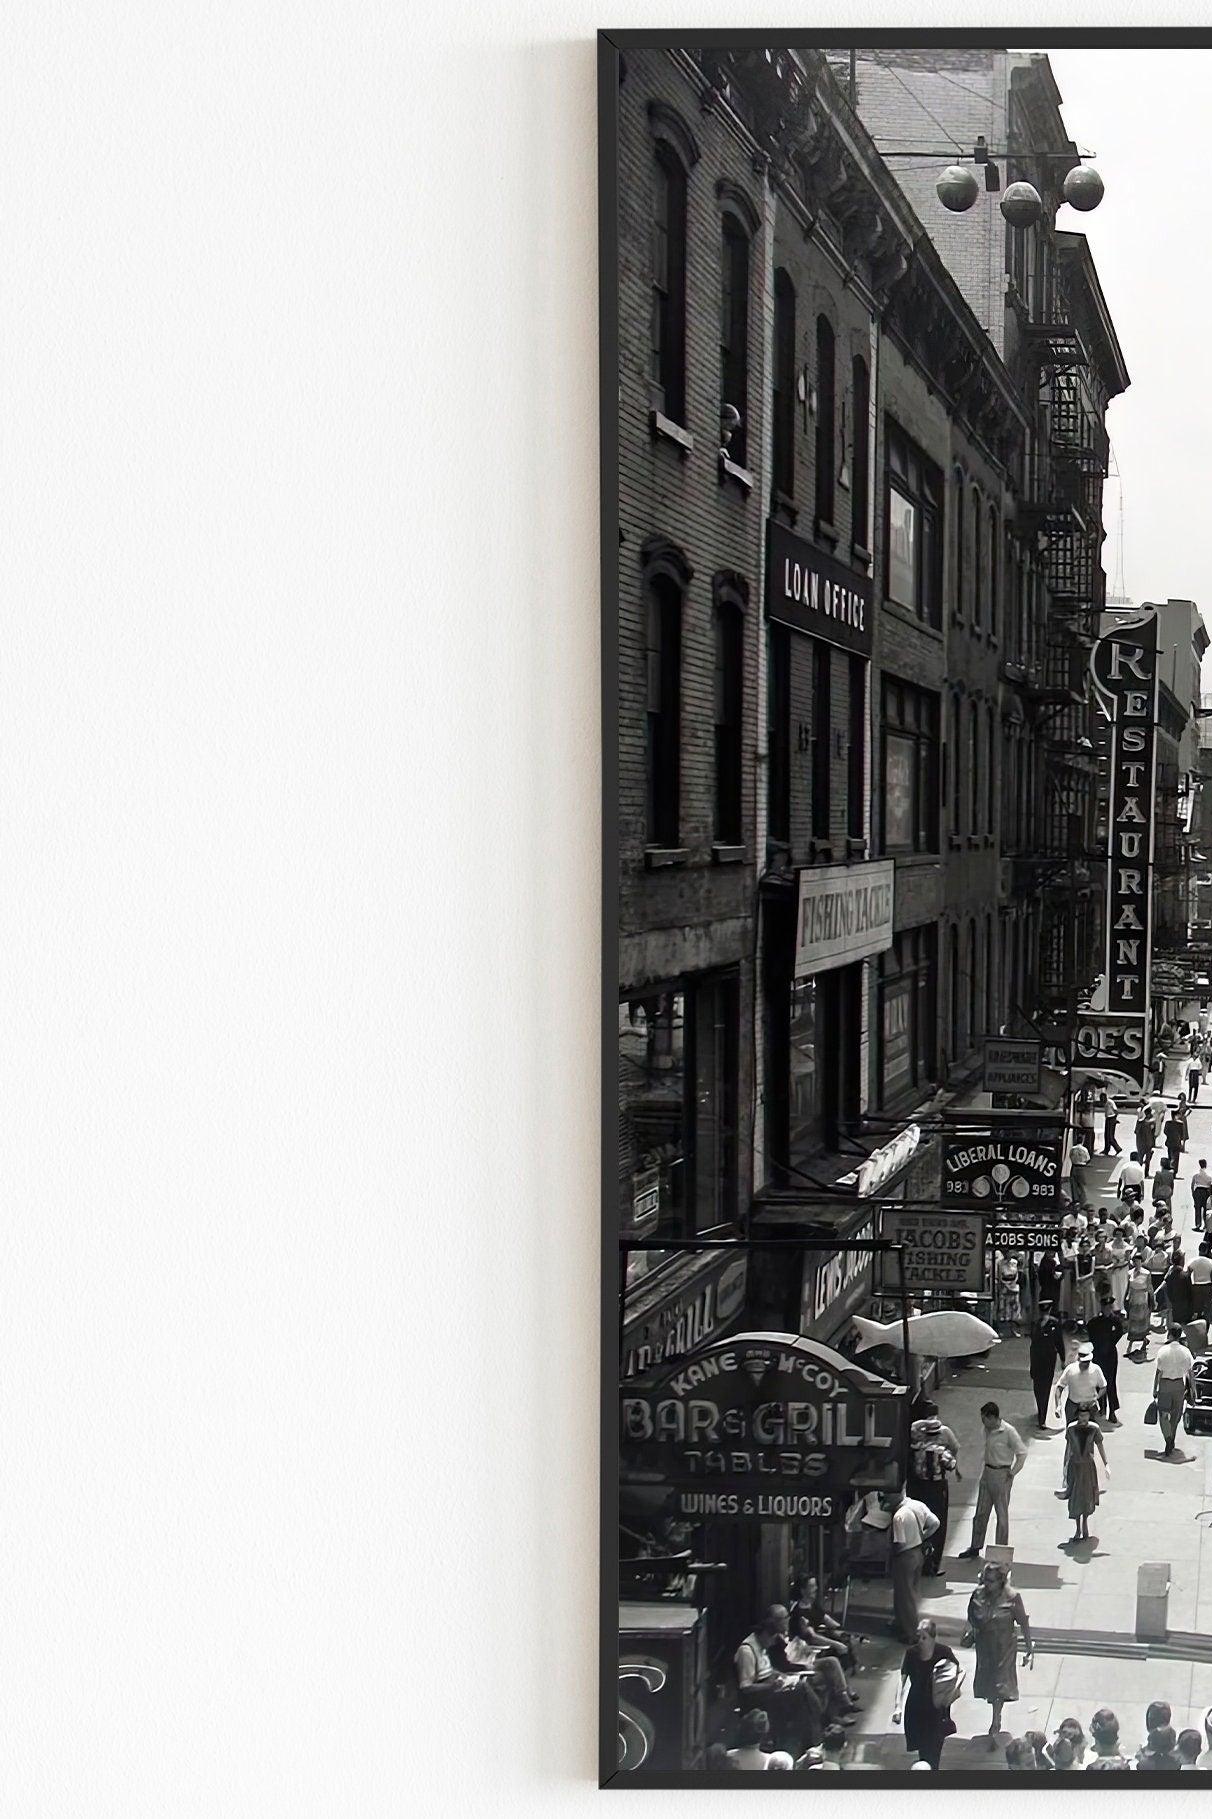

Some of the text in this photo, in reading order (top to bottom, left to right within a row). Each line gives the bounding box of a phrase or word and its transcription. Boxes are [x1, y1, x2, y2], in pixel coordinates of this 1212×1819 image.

[784, 558, 865, 632] LOAN OFFICE
[1106, 641, 1152, 1001] RESTAURANT
[801, 891, 851, 948] FISHING
[1070, 1026, 1143, 1060] OES
[946, 1143, 1057, 1177] LIBERAL LOANS
[946, 1180, 969, 1194] 983
[1031, 1184, 1055, 1197] 983
[984, 1232, 1059, 1247] ACOBS SONS
[904, 1251, 971, 1267] ISHING
[669, 1352, 738, 1397] KANE
[622, 1398, 720, 1442] BAR
[752, 1401, 893, 1448] GRILL
[683, 1450, 829, 1477] TABLES
[681, 1493, 833, 1517] WINES & LIQUORS
